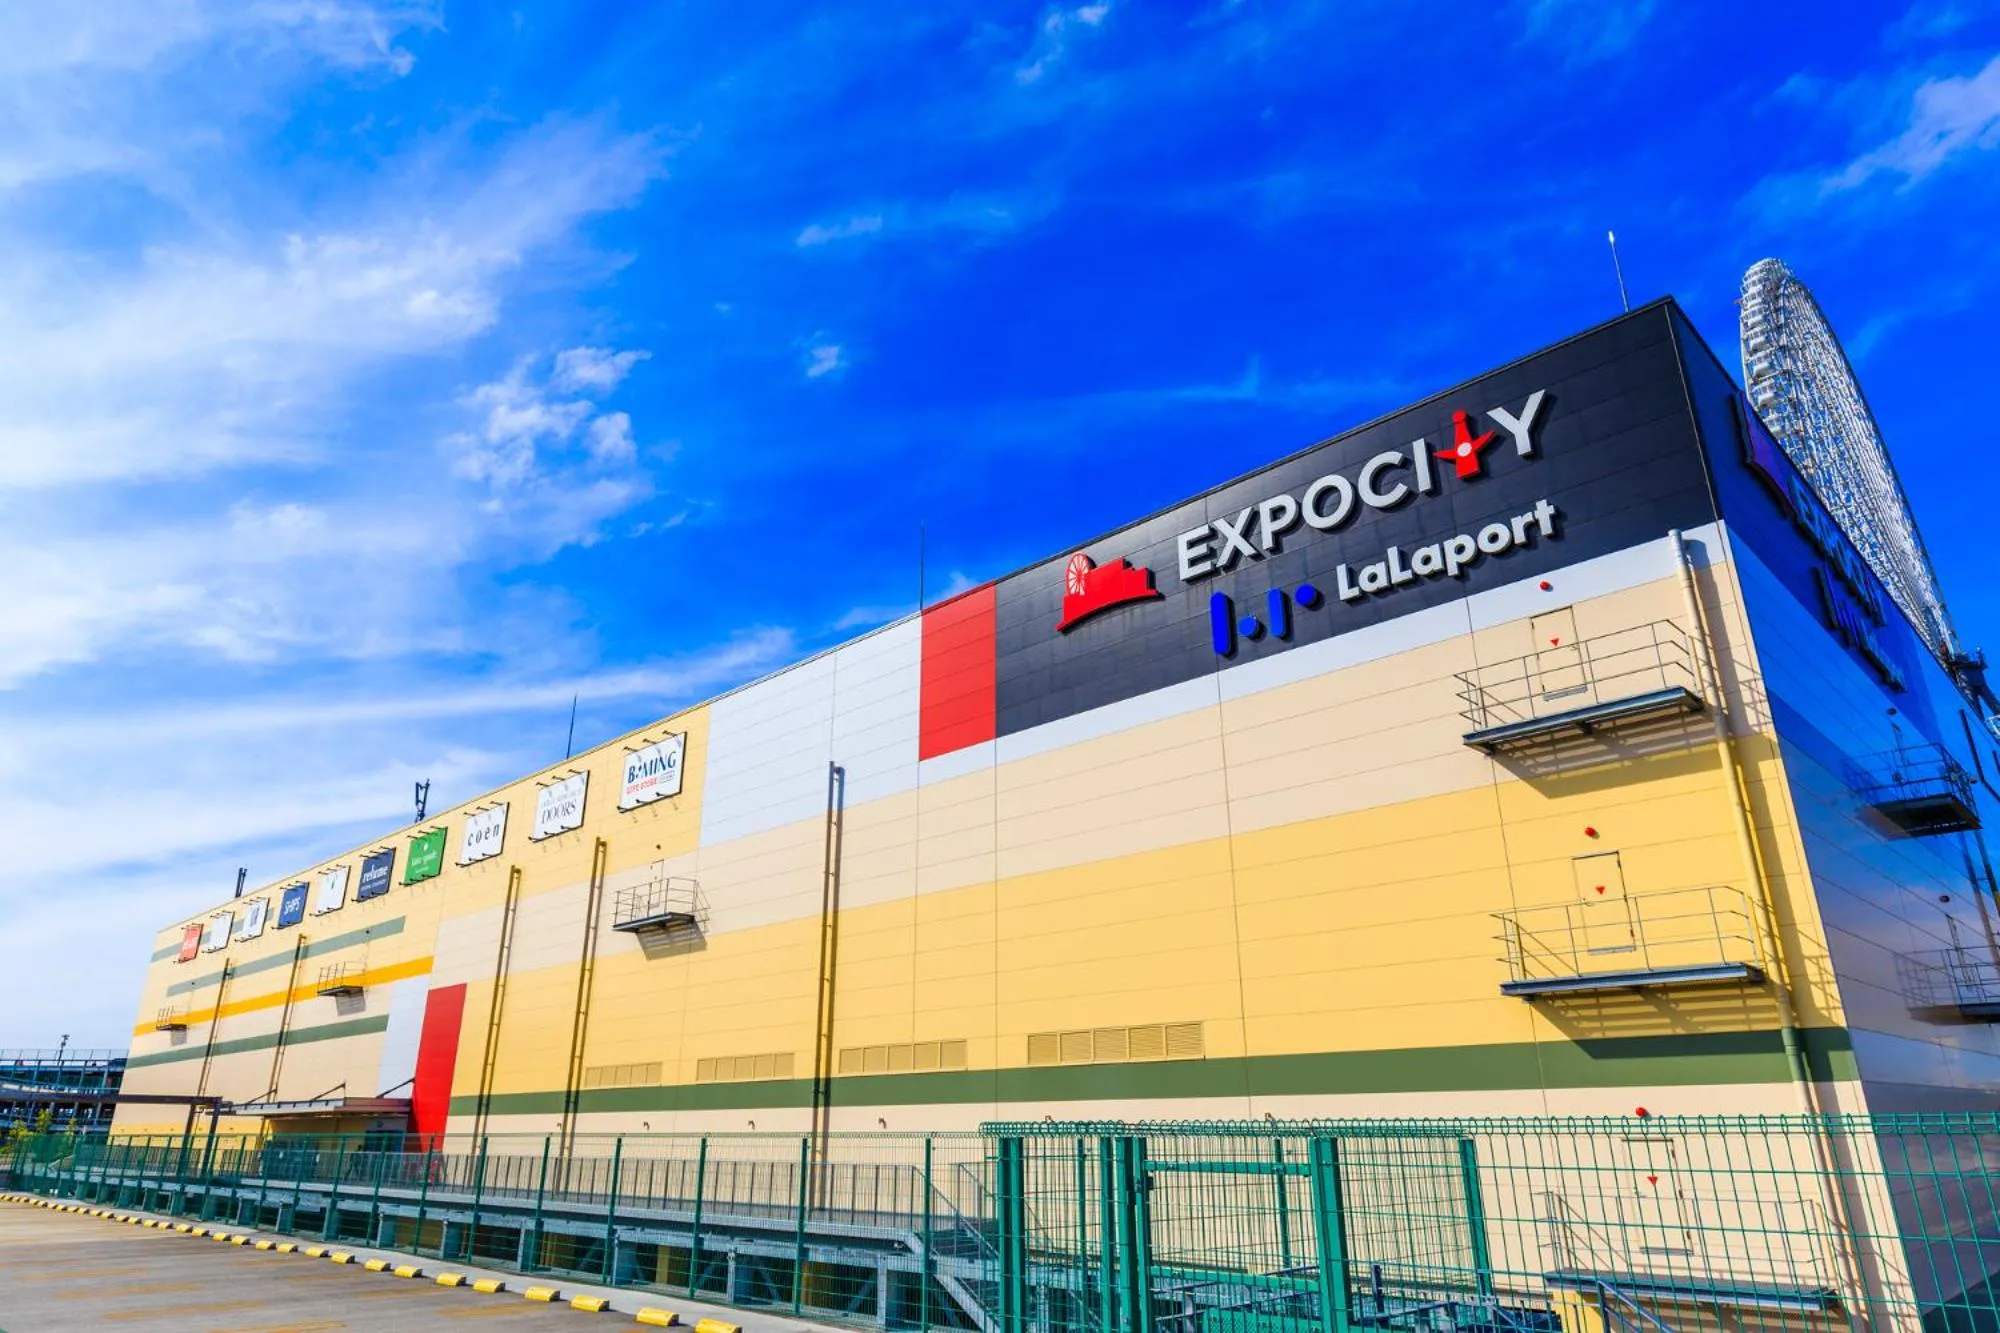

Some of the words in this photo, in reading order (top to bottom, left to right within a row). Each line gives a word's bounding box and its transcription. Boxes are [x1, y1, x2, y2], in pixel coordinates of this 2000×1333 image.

[1177, 389, 1548, 583] EXPOCITY
[1336, 498, 1558, 601] LaLaport
[467, 822, 500, 847] coen
